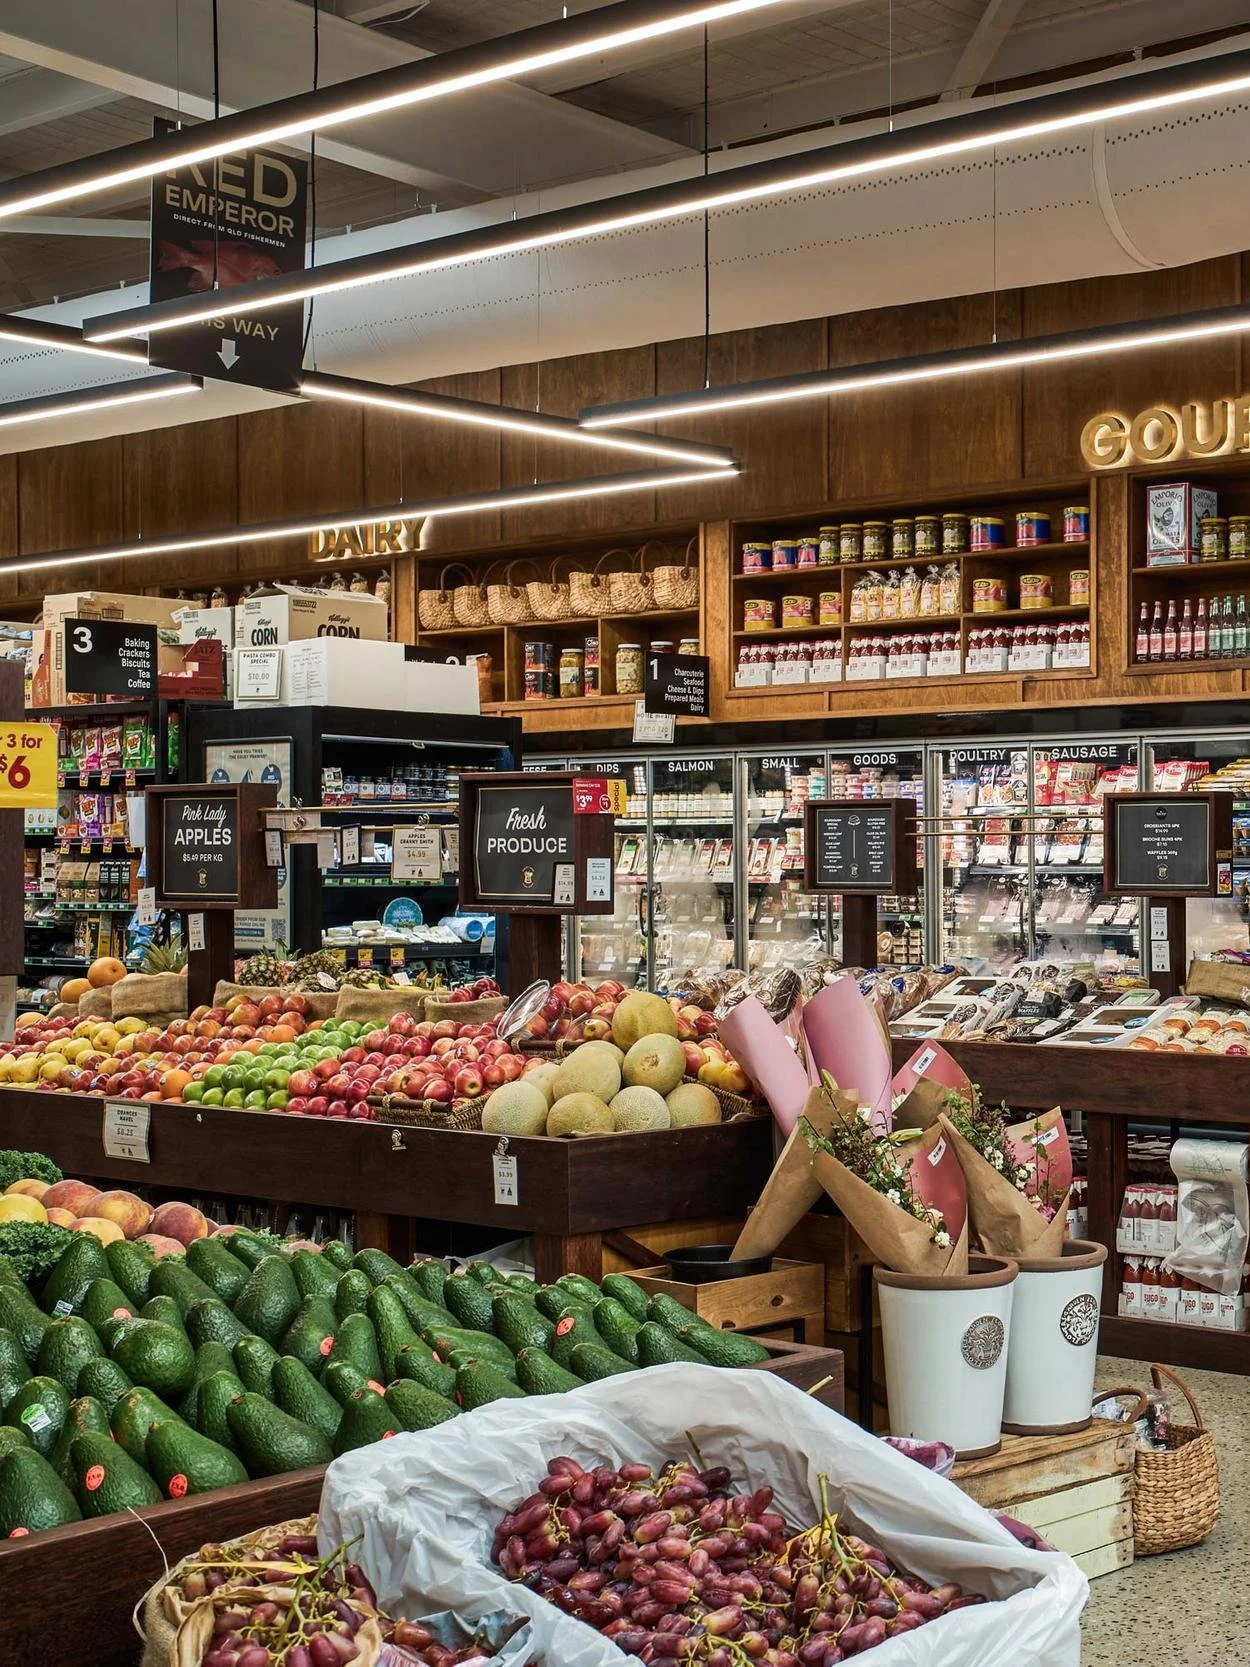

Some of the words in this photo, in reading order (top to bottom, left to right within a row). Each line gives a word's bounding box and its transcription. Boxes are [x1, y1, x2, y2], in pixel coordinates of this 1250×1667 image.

[165, 184, 294, 238] EMPEROR
[173, 213, 201, 226] DIRECT
[227, 228, 242, 236] QLD
[244, 232, 286, 248] FISHERMEN
[233, 318, 279, 340] WAY
[1151, 490, 1182, 505] EMPORIO
[310, 515, 427, 559] DAIRY
[72, 626, 93, 653] 3
[251, 627, 278, 646] CORN
[125, 637, 150, 650] Baking
[118, 647, 150, 658] Crackers
[121, 658, 150, 668] Biscuits
[650, 658, 658, 680] 1
[138, 669, 151, 678] Tea
[674, 668, 704, 677] Charcuterie
[127, 678, 151, 689] Coffee
[683, 677, 704, 686] Seafood
[667, 685, 686, 693] Cheese
[693, 687, 704, 695] Dips
[665, 693, 688, 702] Prepared
[689, 695, 704, 703] Meals
[690, 704, 704, 713] Dairy
[7, 734, 17, 748] 3
[21, 733, 43, 748] for
[950, 749, 1006, 763] POULTRY
[1052, 746, 1117, 760] SAUSAGE
[668, 760, 714, 772] SALMON
[762, 758, 800, 769] SMALL
[853, 754, 897, 766] GOODS
[596, 764, 619, 773] DIPS
[182, 804, 202, 821] Pink
[204, 804, 227, 828] Lady
[506, 805, 547, 830] Fresh
[174, 828, 232, 845] APPLES
[487, 838, 567, 853] PRODUCE
[183, 853, 198, 862] $5.49
[200, 853, 213, 861] PER
[213, 853, 223, 861] KG
